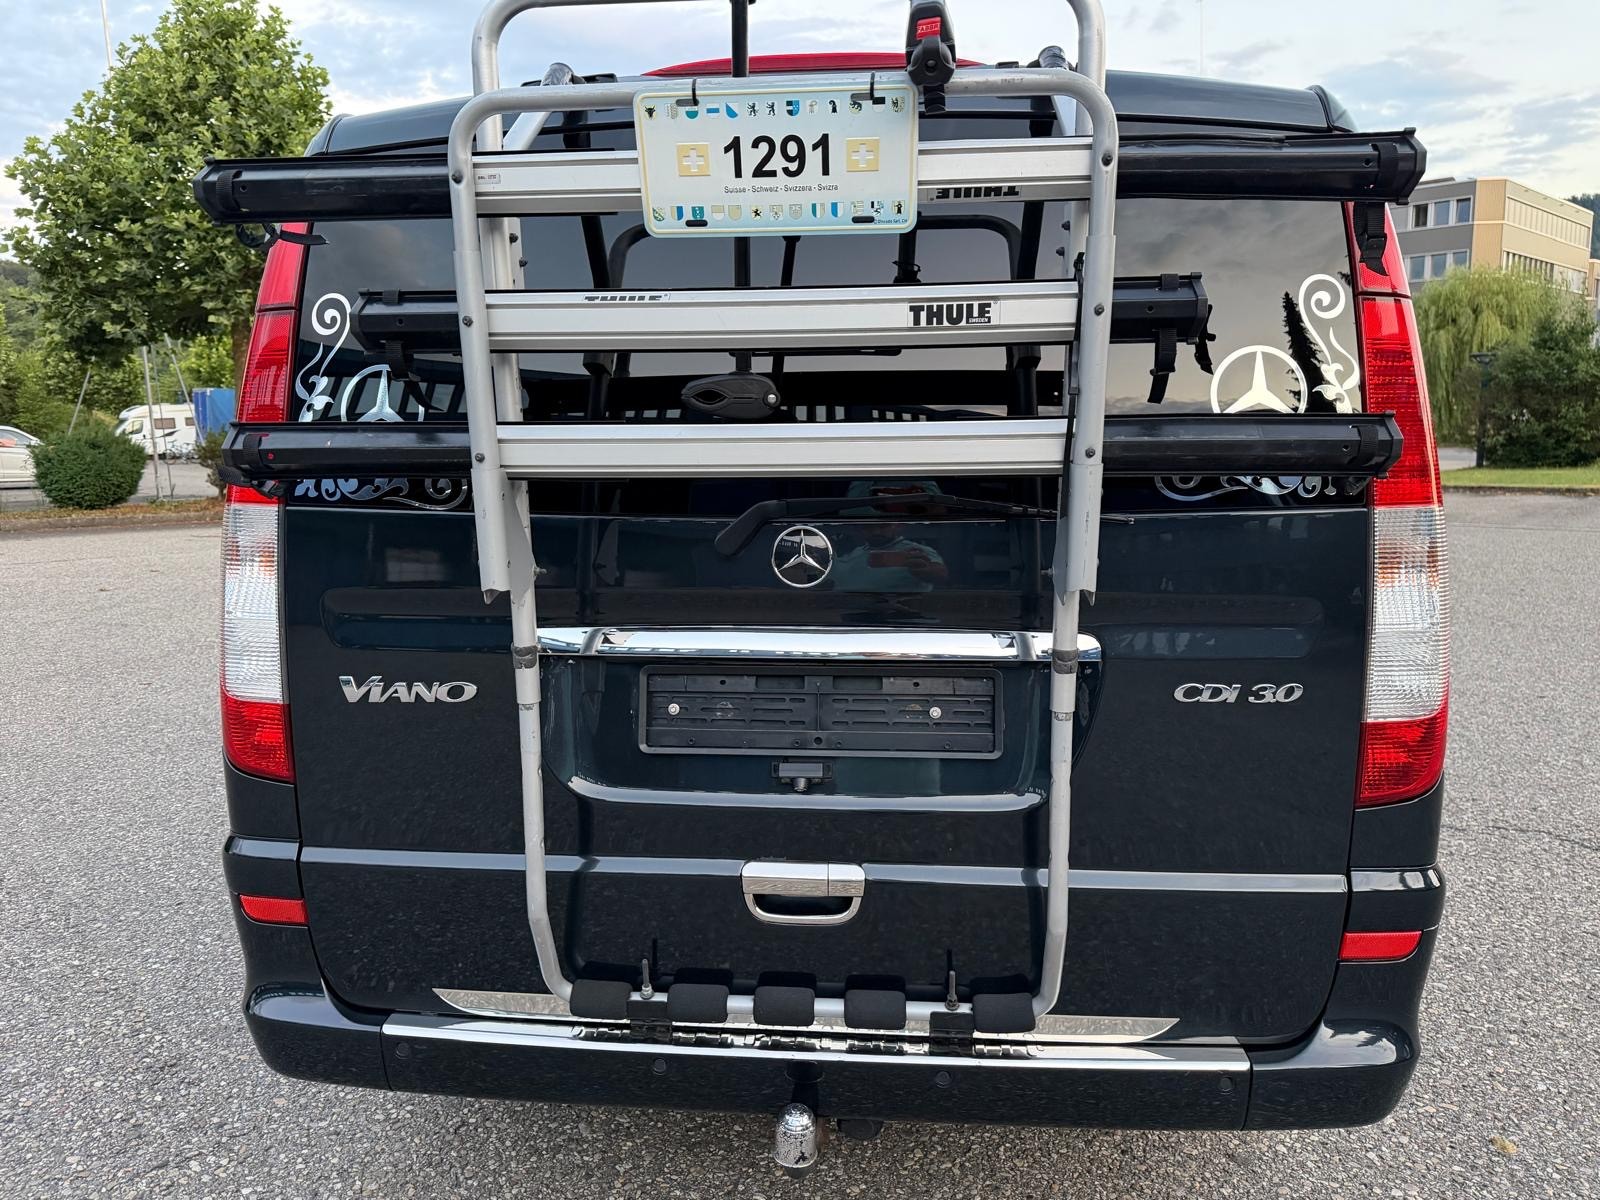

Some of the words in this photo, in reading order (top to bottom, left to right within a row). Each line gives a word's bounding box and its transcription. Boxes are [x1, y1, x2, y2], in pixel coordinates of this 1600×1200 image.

[723, 133, 830, 179] 1291
[724, 185, 747, 194] Suisse
[751, 184, 780, 193] Schweiz
[783, 184, 813, 192] Svizzera
[817, 183, 839, 191] Svizra
[908, 302, 992, 327] THULE
[1173, 682, 1242, 703] CDI
